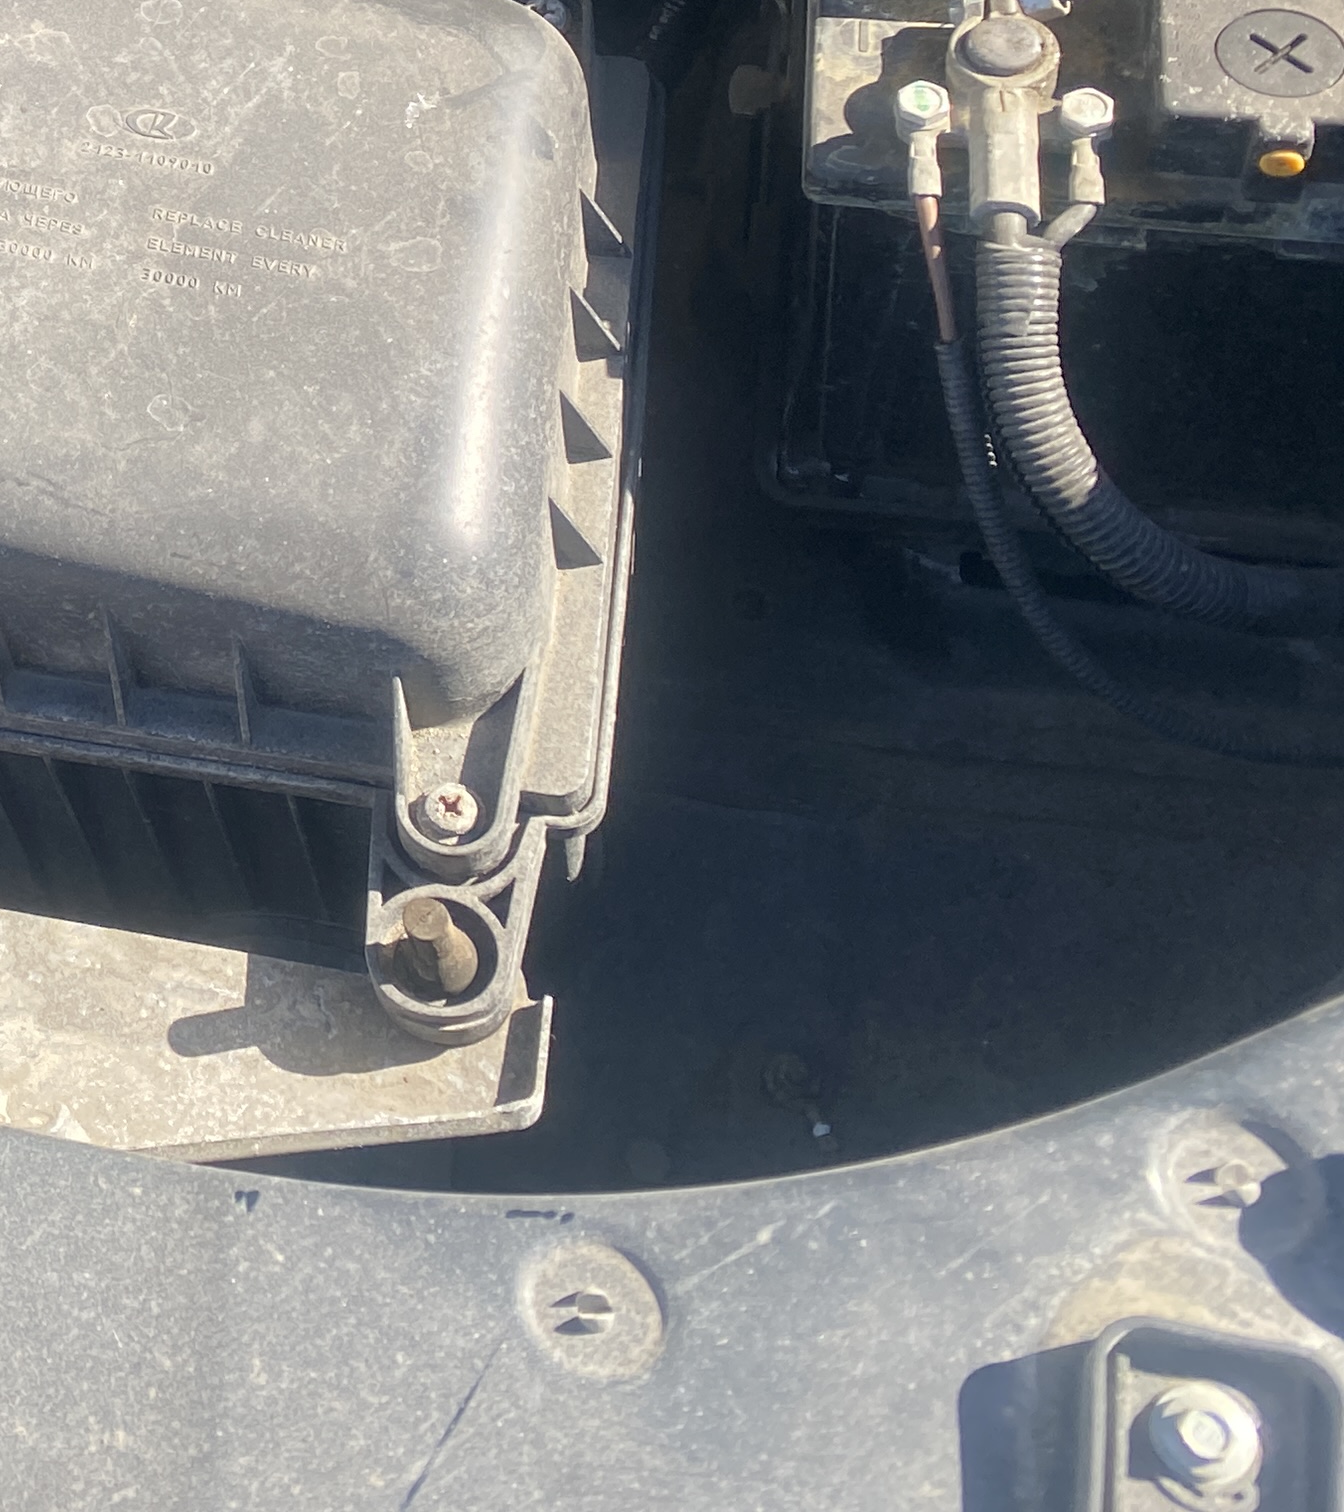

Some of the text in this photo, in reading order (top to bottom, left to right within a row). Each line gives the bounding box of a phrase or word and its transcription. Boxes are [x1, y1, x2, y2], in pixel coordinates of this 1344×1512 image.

[79, 141, 215, 176] 2123-1109010
[23, 212, 85, 236] ЧЕРЕЗ
[151, 206, 348, 254] REPLACE CLEANER
[146, 237, 318, 280] ELEMENT EVERY
[139, 267, 243, 298] 30000 KM
